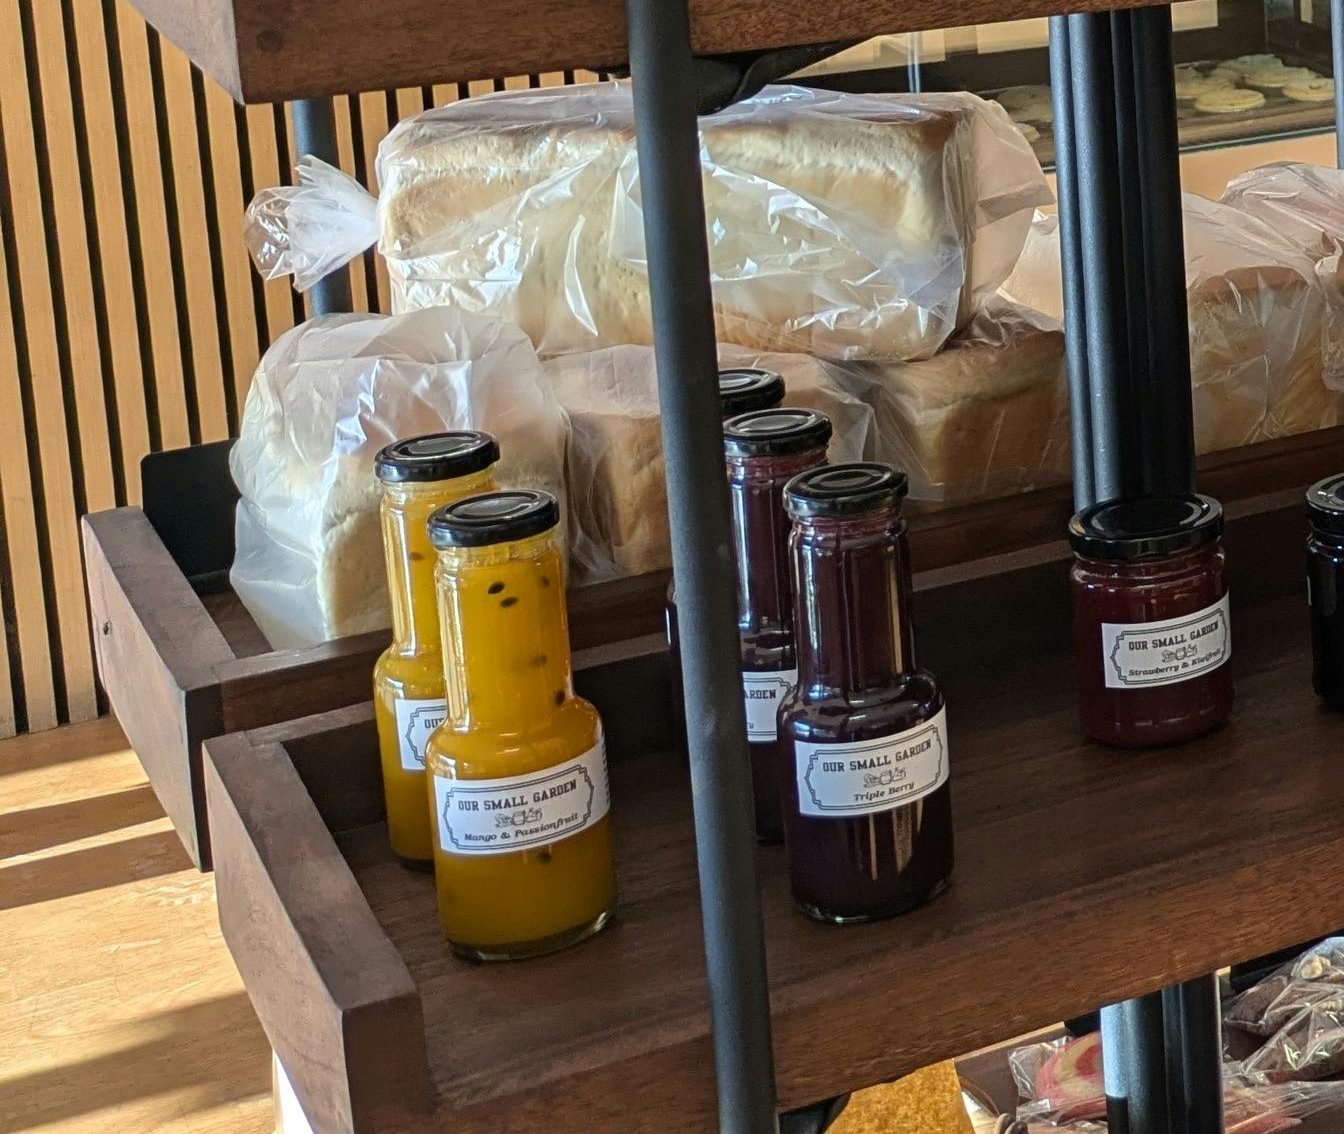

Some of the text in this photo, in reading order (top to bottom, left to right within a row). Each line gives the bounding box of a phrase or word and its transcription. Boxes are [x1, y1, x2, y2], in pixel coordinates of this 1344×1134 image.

[1128, 620, 1219, 651] OUR SMALL GARDEN
[1128, 648, 1221, 677] Strawberry & Kiwifruit
[744, 689, 776, 699] ARDEN
[822, 739, 932, 773] OUR SMALL GARDEN
[458, 779, 577, 811] OUR SMALL GARDEN
[854, 783, 915, 802] Triple Berry
[464, 812, 578, 842] Mango & Passionfruit
